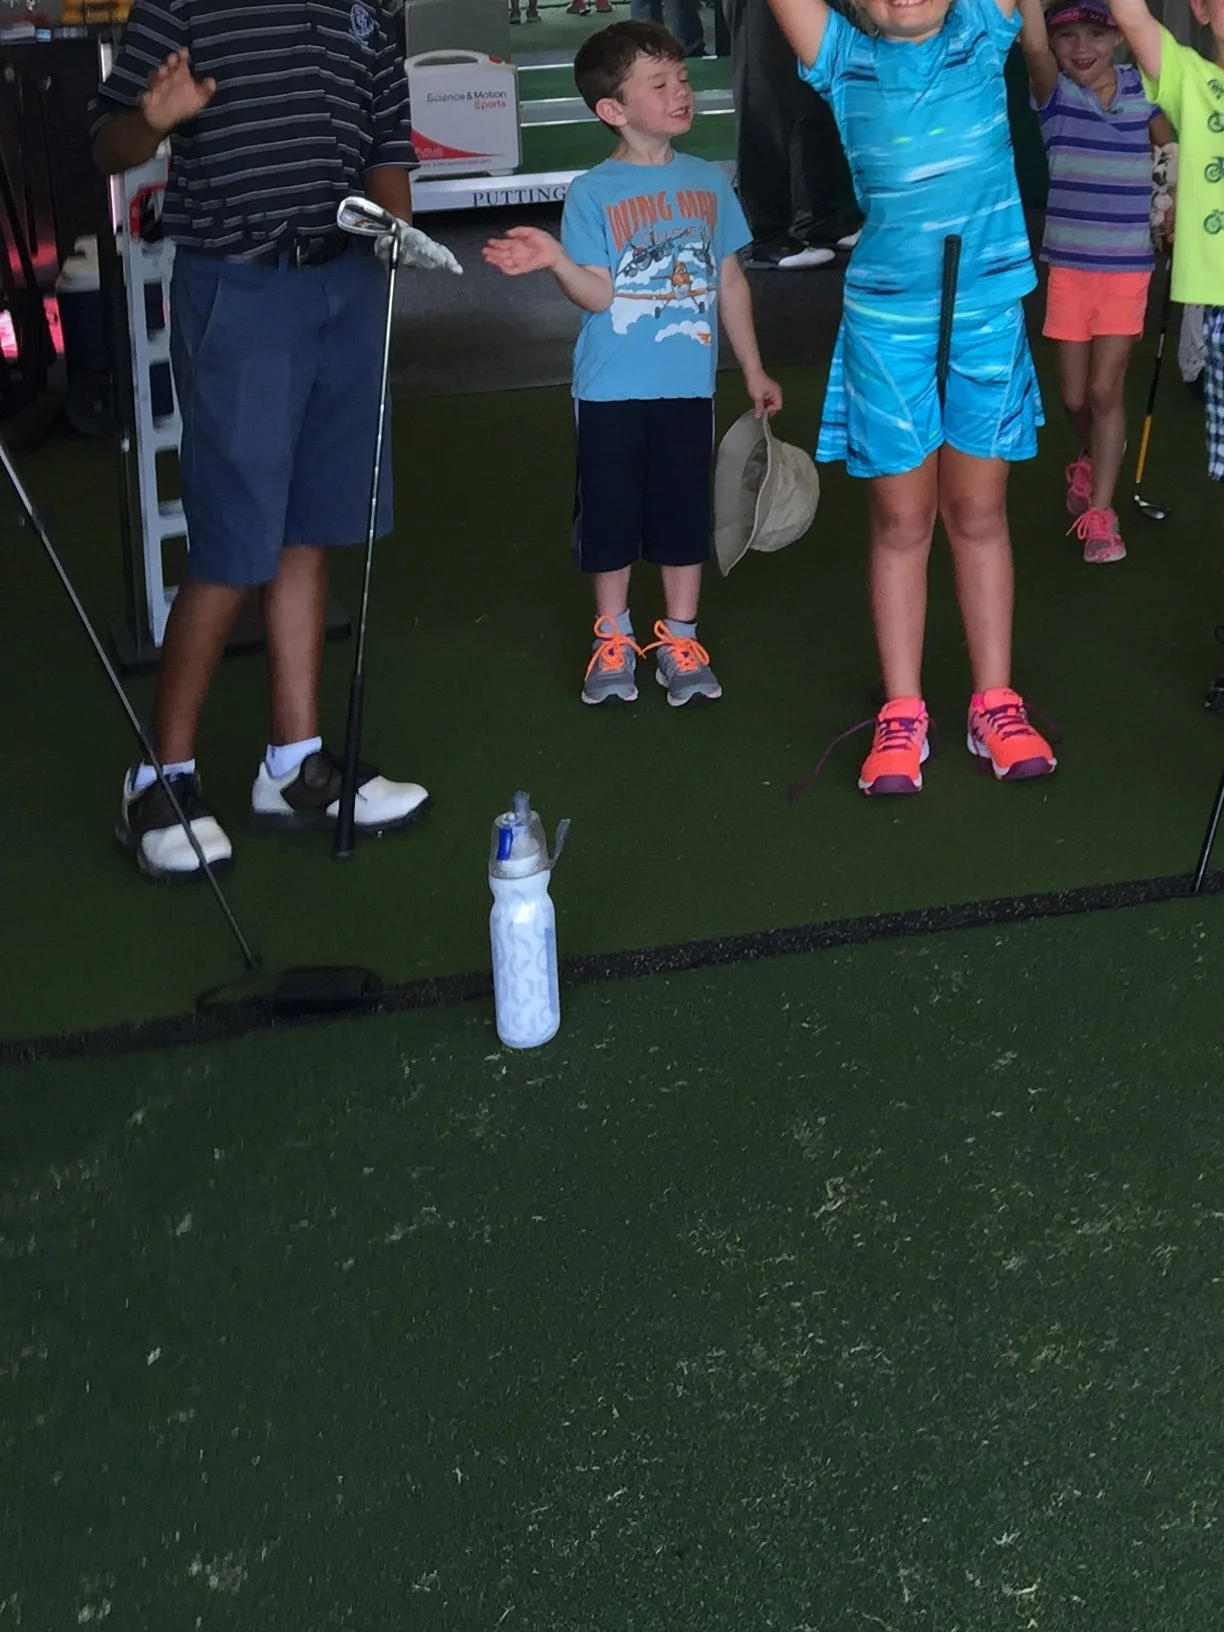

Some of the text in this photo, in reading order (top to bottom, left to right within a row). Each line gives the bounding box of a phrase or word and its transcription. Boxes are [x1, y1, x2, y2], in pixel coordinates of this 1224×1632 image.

[426, 92, 465, 103] Science
[474, 90, 508, 99] Motion
[474, 99, 507, 110] Sports
[472, 186, 567, 207] PUTTING
[605, 190, 673, 251] WING
